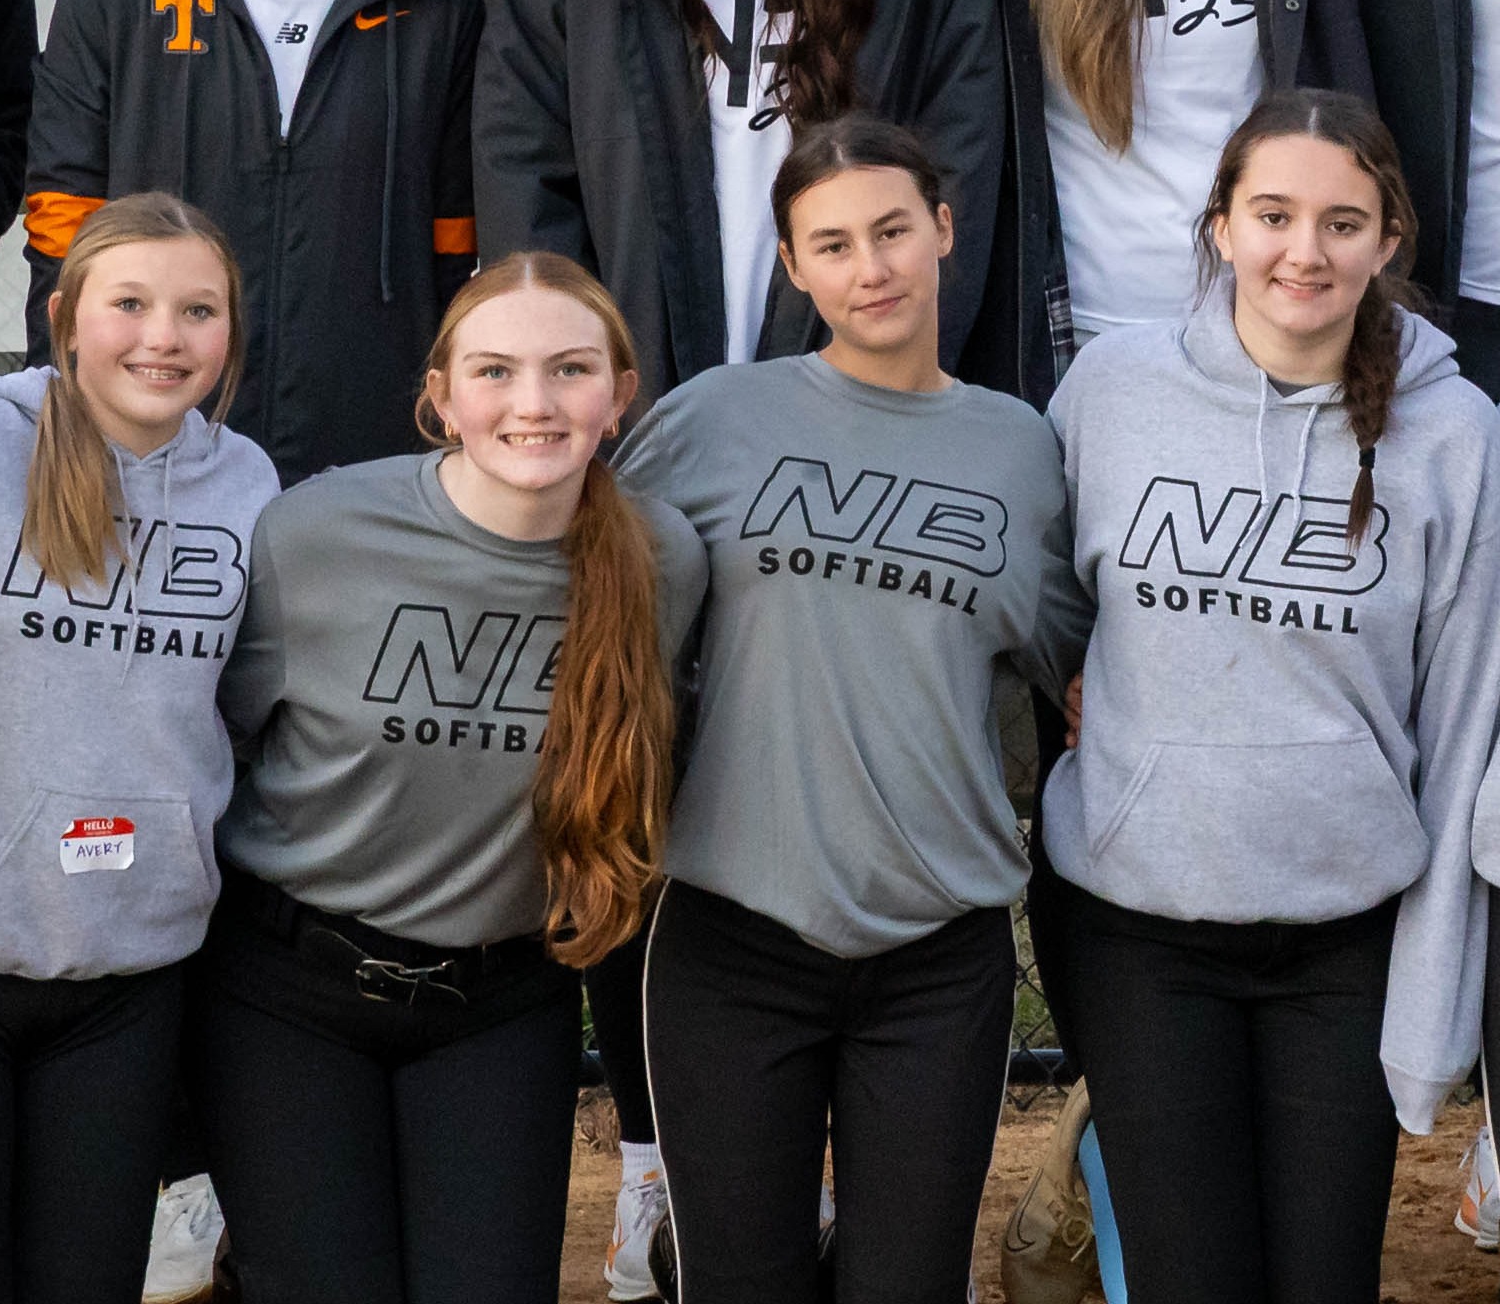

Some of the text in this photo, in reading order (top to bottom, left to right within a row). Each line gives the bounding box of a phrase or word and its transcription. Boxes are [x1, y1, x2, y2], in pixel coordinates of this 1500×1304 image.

[739, 456, 1008, 578] NB
[1118, 476, 1390, 596] NB
[758, 547, 979, 616] SOFTBALL
[1135, 581, 1359, 634] SOFTBALL
[20, 610, 226, 660] SOFTBALL
[381, 716, 548, 753] SOFTB
[76, 841, 123, 858] AVERY
[83, 820, 114, 831] HELLO
